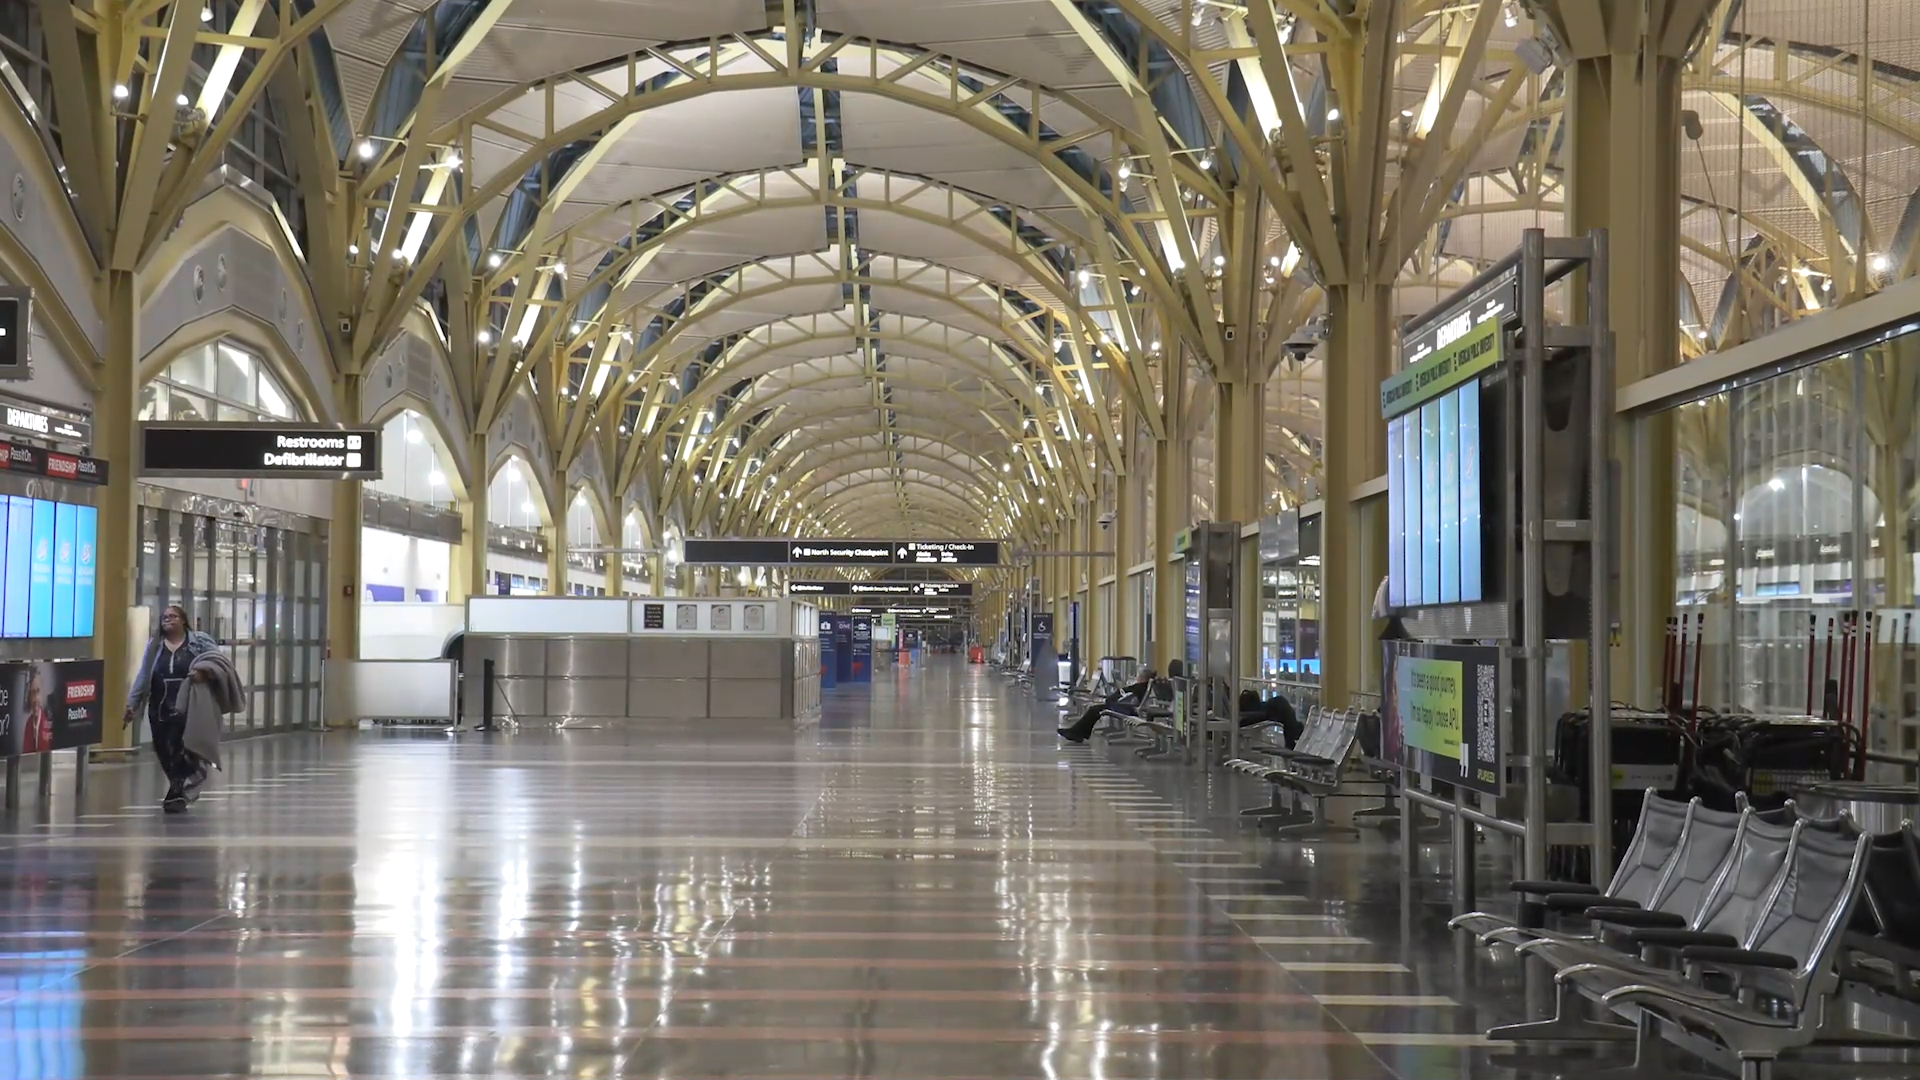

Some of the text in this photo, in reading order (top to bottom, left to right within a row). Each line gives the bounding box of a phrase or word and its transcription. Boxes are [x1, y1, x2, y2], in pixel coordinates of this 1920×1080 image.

[7, 407, 49, 433] DEPARTURES
[276, 435, 345, 448] Restrooms
[48, 457, 77, 475] FRIENDSHIP
[263, 452, 344, 466] Defibrillator
[830, 549, 854, 557] Security
[854, 548, 889, 557] Checkpoint
[917, 543, 944, 551] Ticketing
[948, 543, 975, 551] Check-In
[67, 684, 95, 699] FRIENDSHIP
